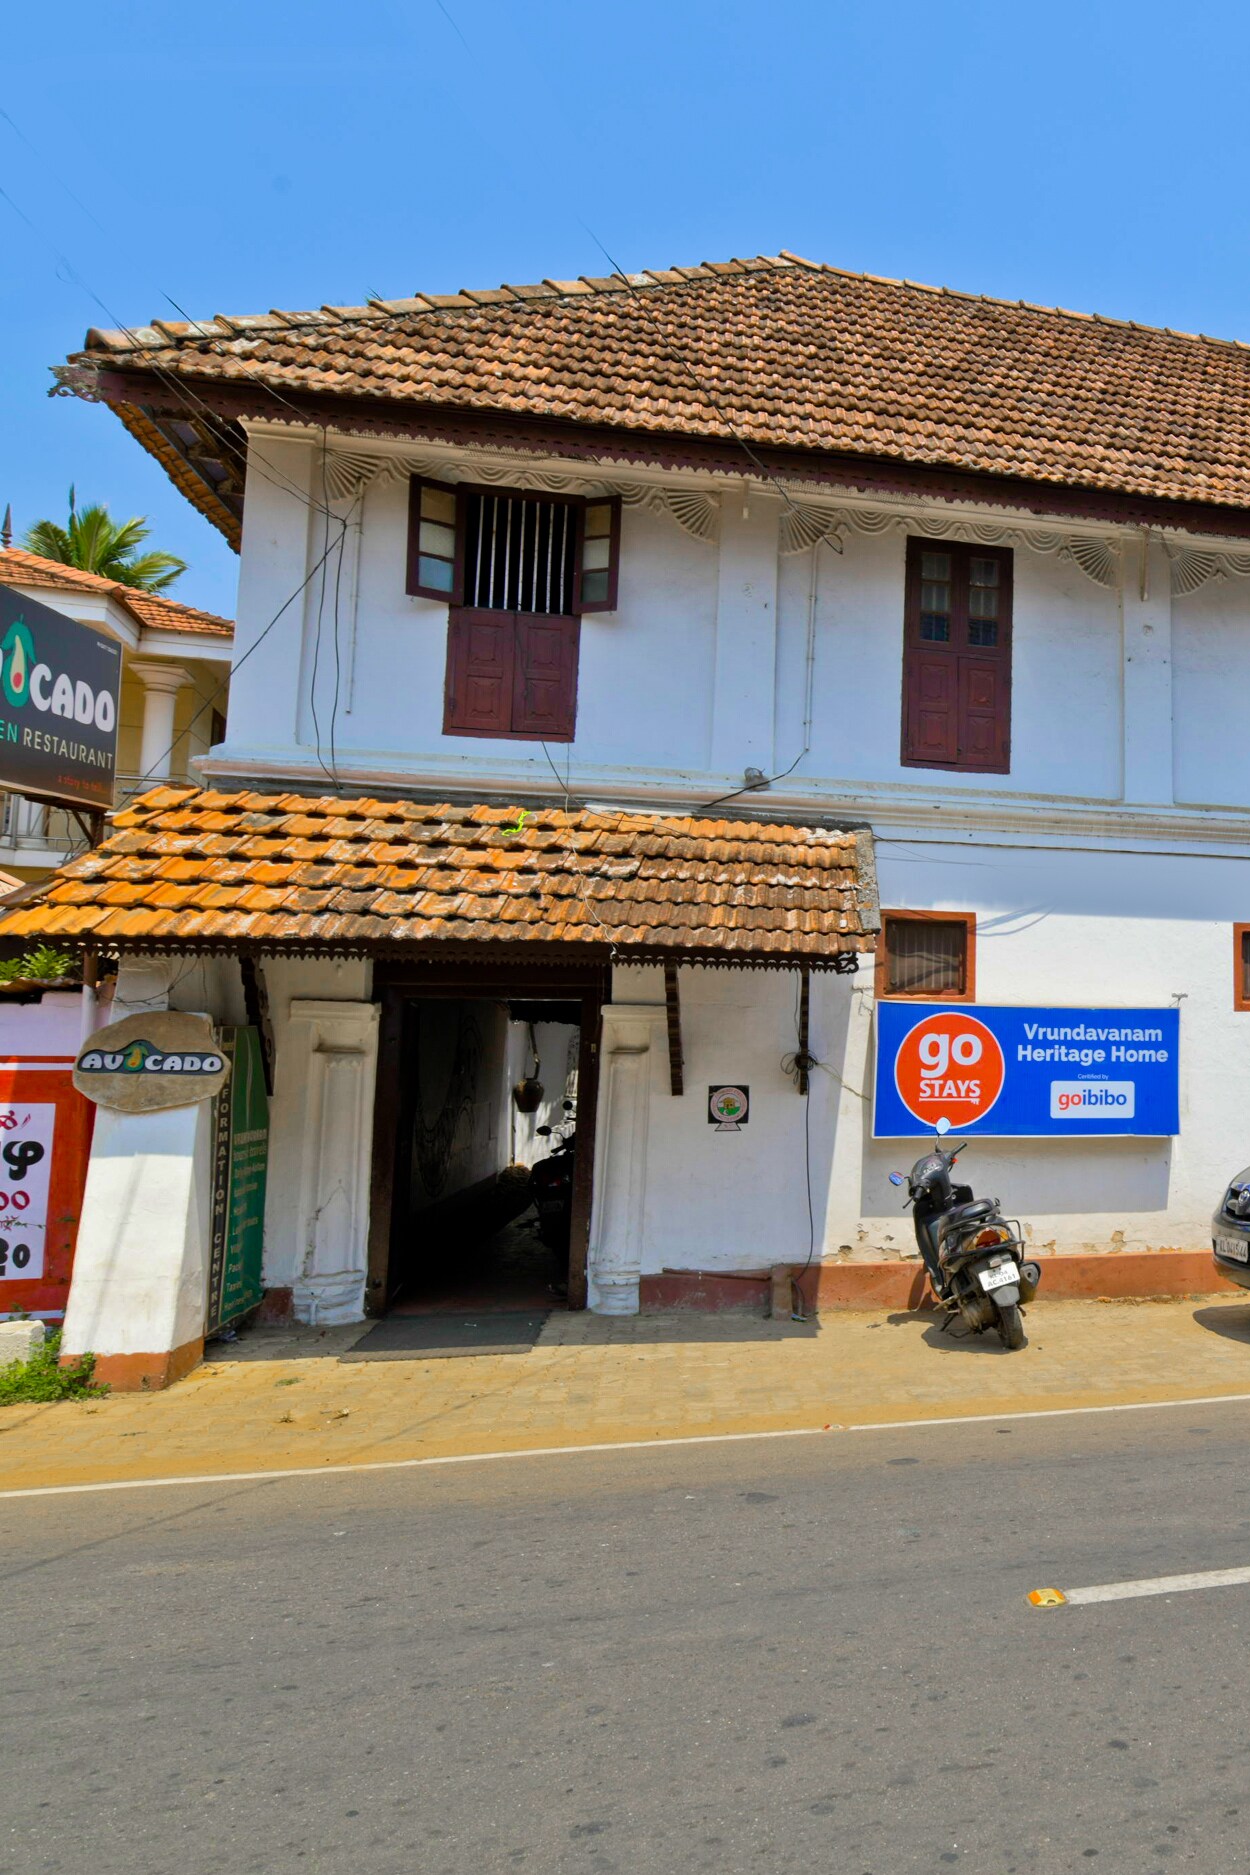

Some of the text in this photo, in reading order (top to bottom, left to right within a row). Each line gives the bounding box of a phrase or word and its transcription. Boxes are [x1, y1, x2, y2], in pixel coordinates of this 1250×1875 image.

[23, 727, 114, 770] RESTAURANT
[1023, 1023, 1163, 1042] Vrundavanam
[918, 1033, 983, 1079] go
[1017, 1045, 1169, 1066] Heritage Home
[1101, 1073, 1109, 1081] by
[919, 1079, 981, 1098] STAYS
[1058, 1089, 1127, 1110] goibibo
[214, 1074, 230, 1216] FORMATION
[210, 1233, 225, 1318] CENTRE
